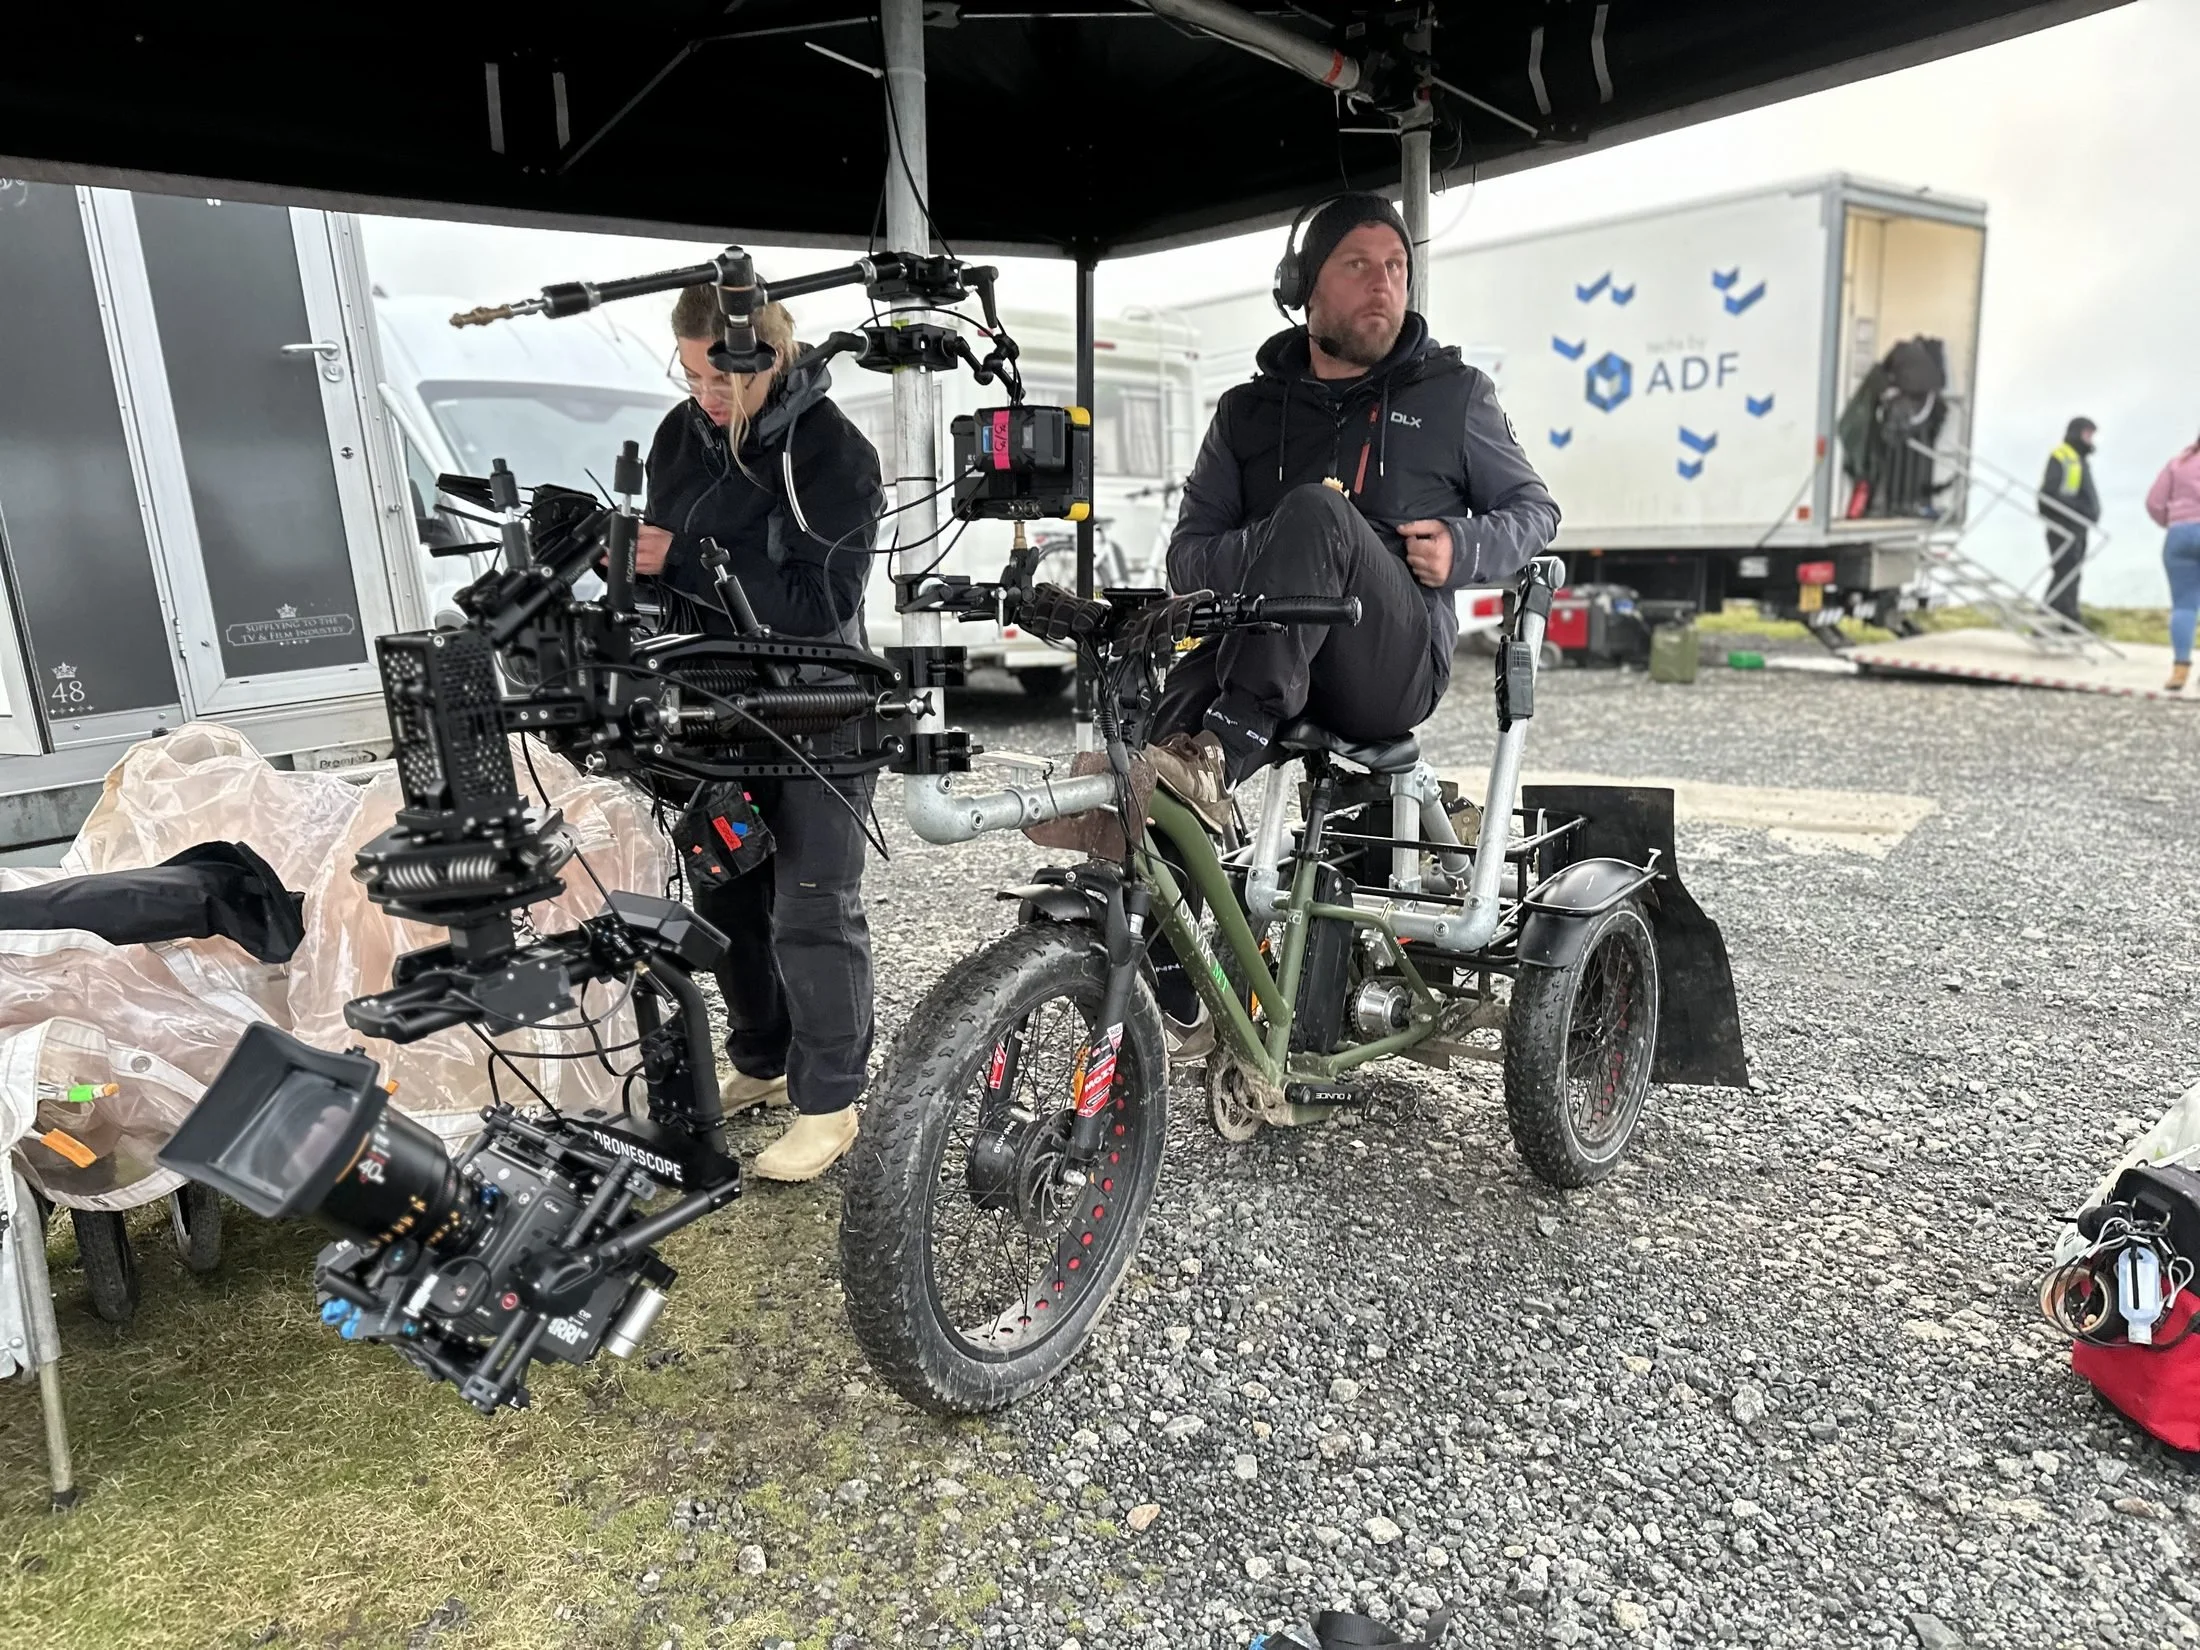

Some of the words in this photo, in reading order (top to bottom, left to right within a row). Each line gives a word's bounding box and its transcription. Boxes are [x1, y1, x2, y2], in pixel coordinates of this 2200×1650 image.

[1645, 351, 1740, 396] ADF
[1390, 411, 1422, 428] DLX
[240, 633, 255, 643] TV
[258, 632, 268, 641] &
[269, 630, 294, 641] FILM
[295, 625, 345, 638] INDUSTRY
[245, 621, 300, 633] SUPPLYING
[303, 619, 318, 627] TO
[319, 616, 338, 626] THE
[51, 680, 86, 703] 48
[593, 1130, 683, 1182] DRONESCOPE
